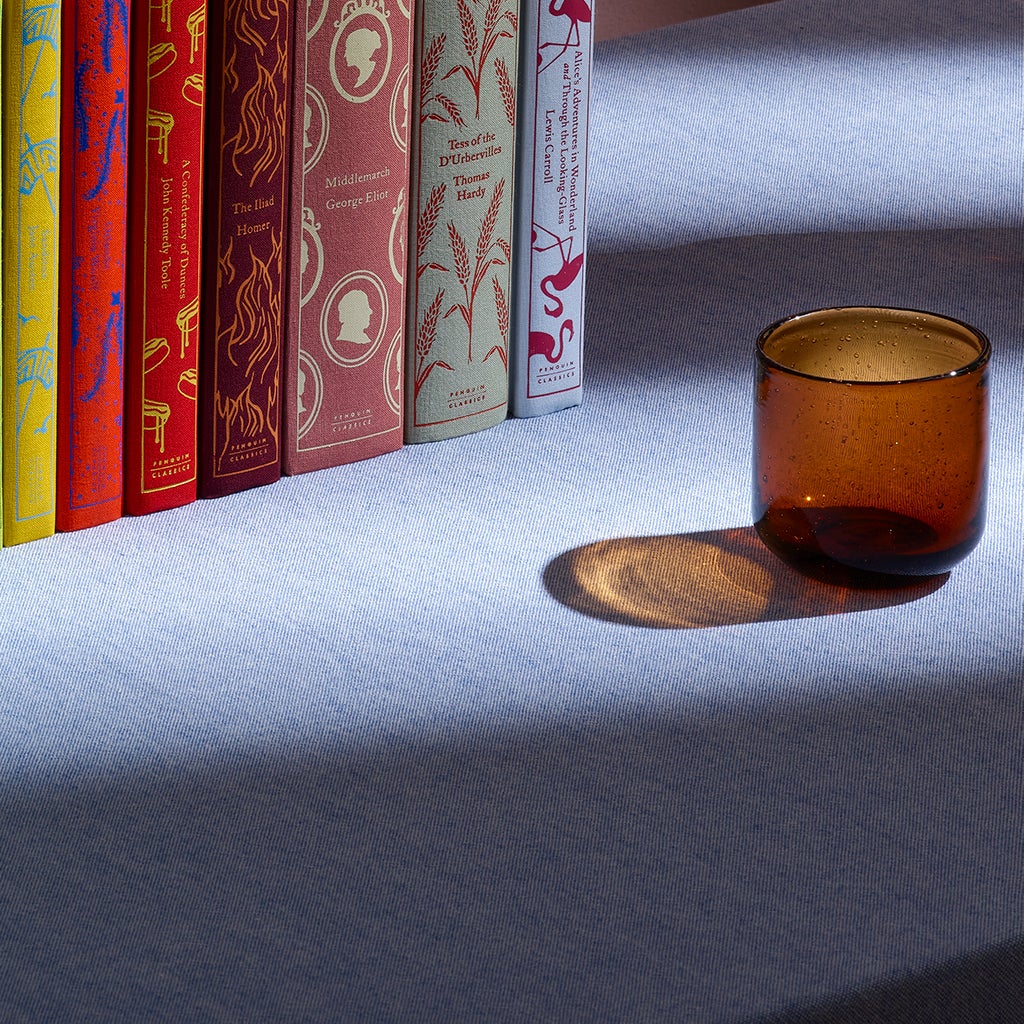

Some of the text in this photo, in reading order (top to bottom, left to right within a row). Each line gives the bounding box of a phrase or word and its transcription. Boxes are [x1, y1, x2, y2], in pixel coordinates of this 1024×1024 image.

[448, 132, 496, 150] Tess of the
[543, 109, 556, 184] Lewis Carroll
[556, 63, 571, 225] and Through the Looking-Glass
[568, 51, 583, 232] Alice's Adventures in Wonderland
[439, 146, 502, 167] D'Urbervilles
[325, 166, 391, 189] Middlemarch
[453, 171, 490, 187] Thomas
[326, 190, 389, 210] George Eliot
[457, 186, 486, 201] Hardy
[231, 195, 275, 215] The Iliad
[159, 177, 174, 290] John Kennedy Toole
[178, 159, 192, 300] A Confederacy of Dunces
[236, 221, 271, 236] Homer
[539, 361, 574, 373] PENGUIN
[537, 371, 575, 384] CLASSICS
[449, 384, 485, 397] PENGUIN
[448, 395, 485, 409] CLASSICS
[153, 453, 190, 467] PENGUIN
[151, 463, 190, 479] CLASSICS
